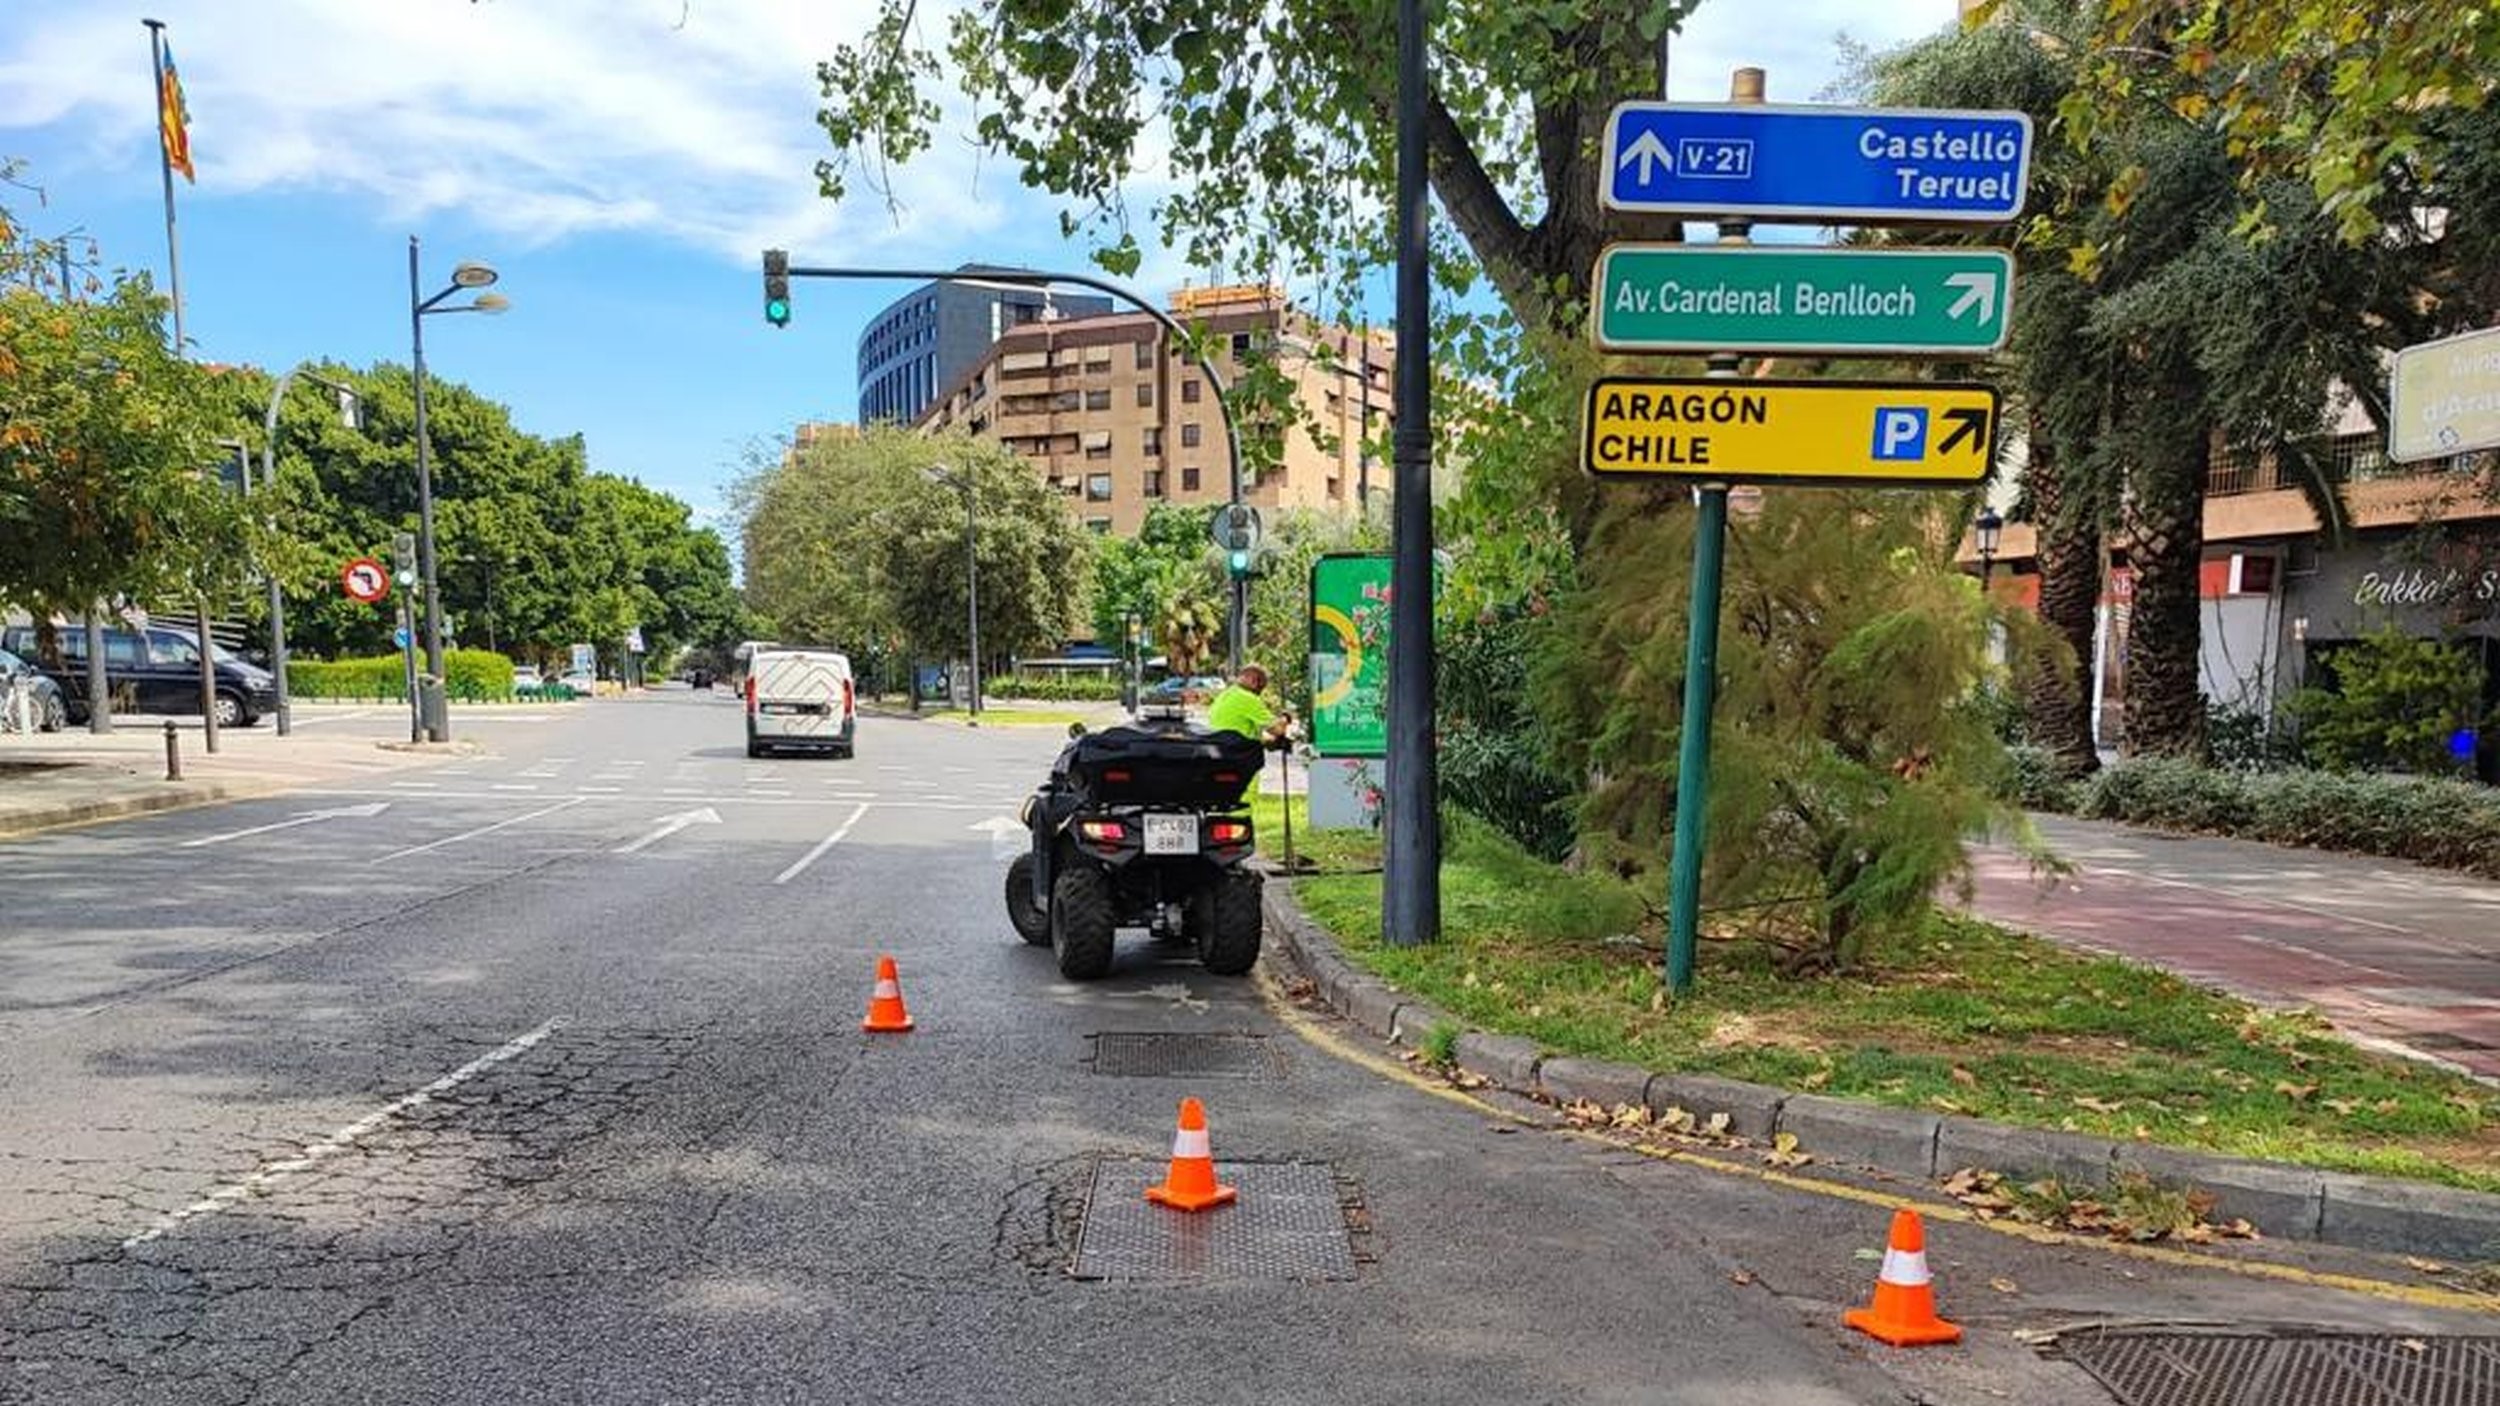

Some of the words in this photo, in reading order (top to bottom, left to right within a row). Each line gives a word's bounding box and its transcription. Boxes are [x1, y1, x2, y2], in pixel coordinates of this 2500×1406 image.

[1685, 146, 1748, 172] V-21
[1860, 127, 2017, 163] Castelló
[1897, 167, 2012, 200] Teruel
[1794, 283, 1917, 317] Benlloch
[1601, 390, 1768, 425] ARAGÓN
[1599, 434, 1711, 465] CHILE
[1883, 411, 1921, 456] P
